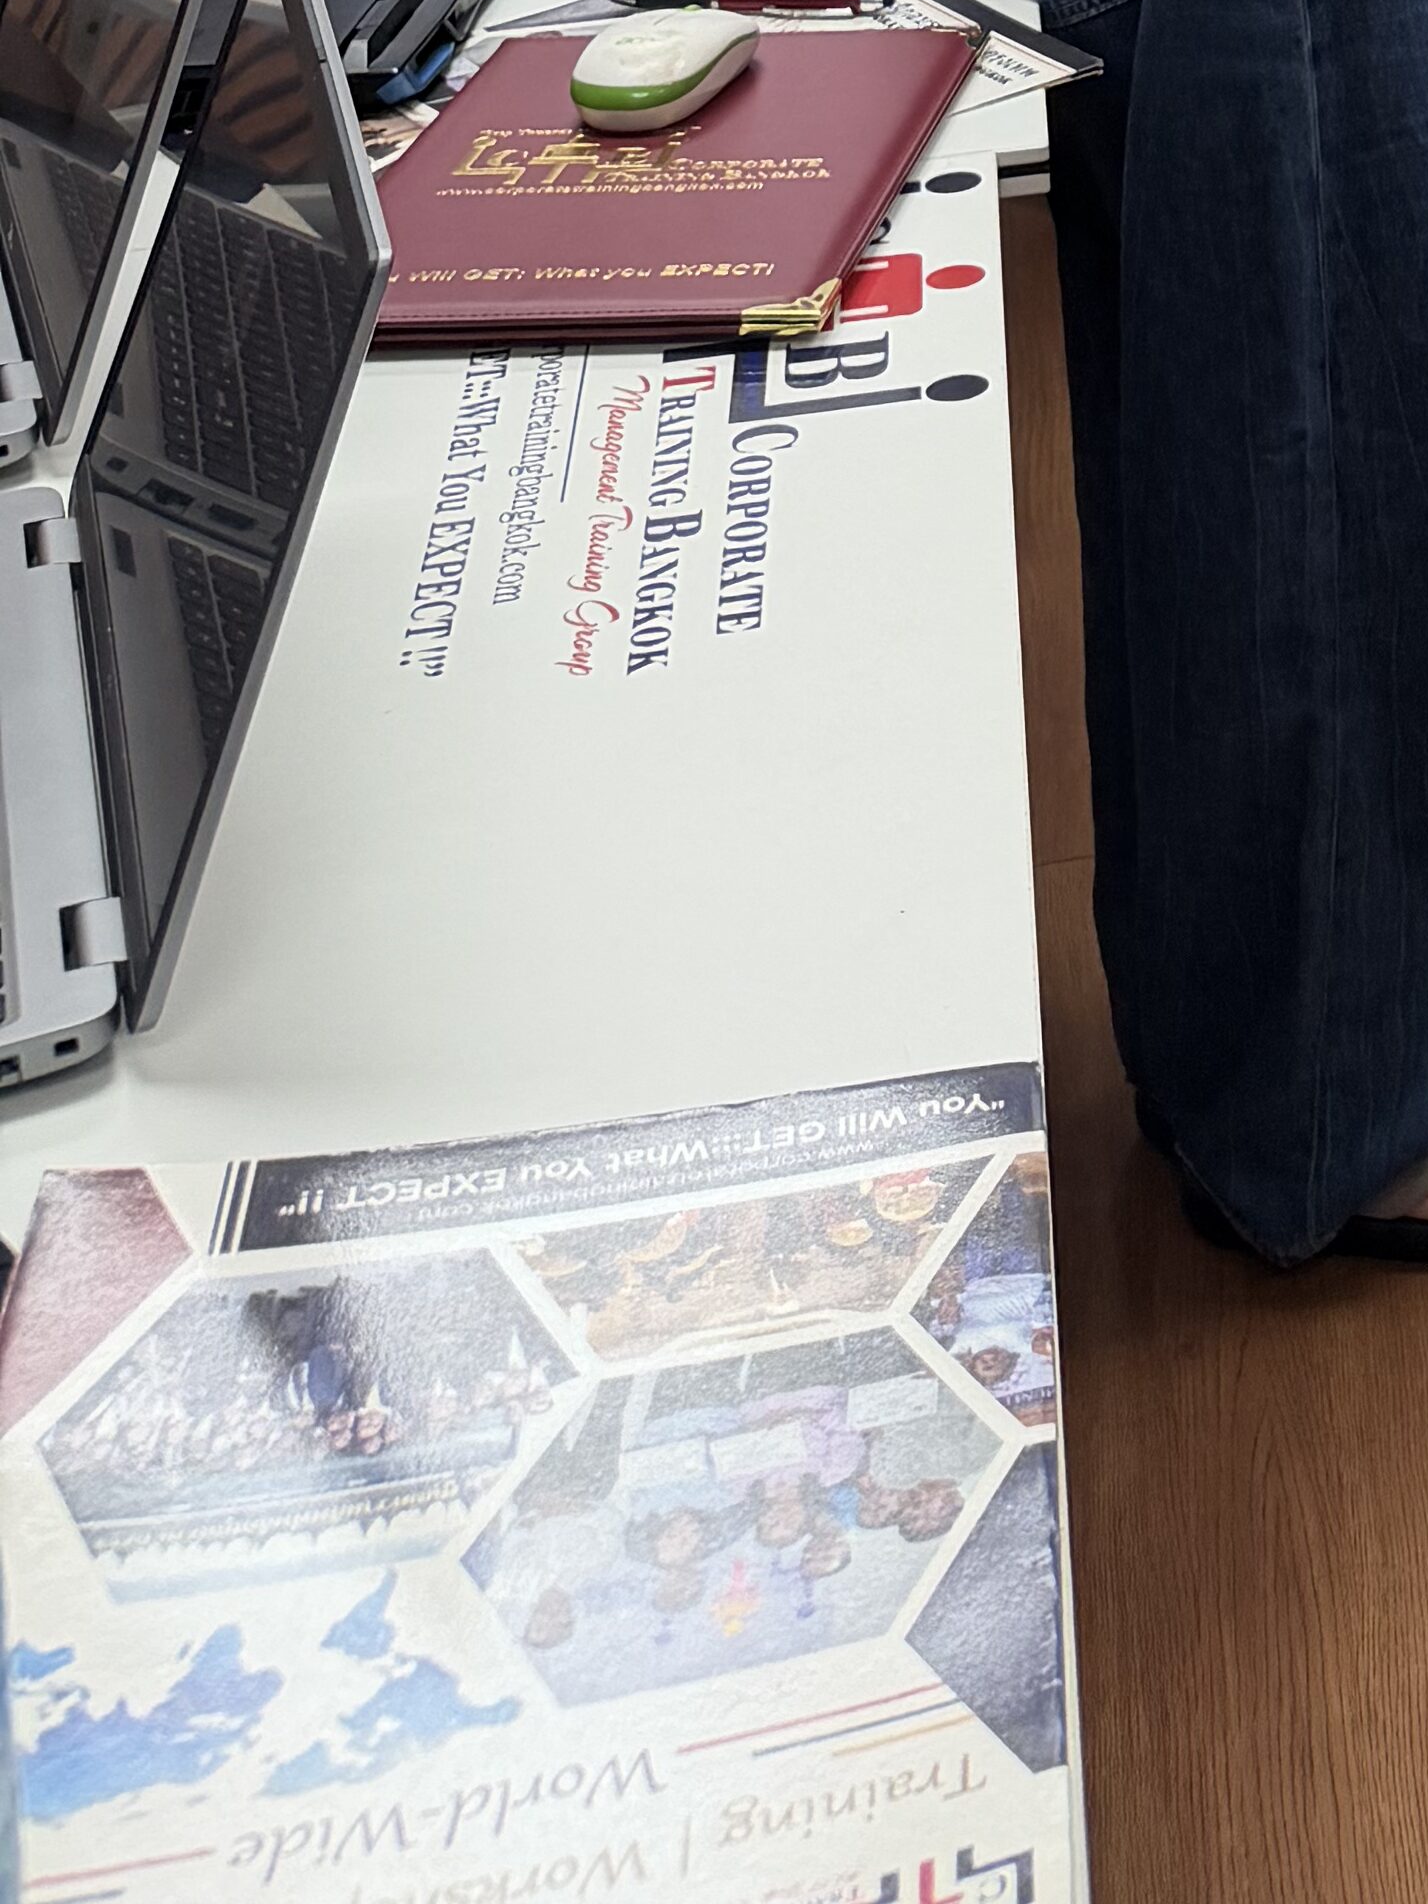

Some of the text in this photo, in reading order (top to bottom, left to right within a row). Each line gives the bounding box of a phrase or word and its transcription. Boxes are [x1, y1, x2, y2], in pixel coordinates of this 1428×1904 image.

[446, 348, 512, 462] ET:::What
[432, 464, 487, 514] You
[492, 346, 568, 606] rporatetrainingbangkok.com
[554, 375, 652, 678] Management Training Group
[626, 365, 717, 677] TRAINING BANGKOK
[715, 422, 801, 636] CORPORATE
[403, 517, 476, 640] EXPECT
[519, 1156, 594, 1184] You
[838, 1104, 908, 1133] Will
[341, 1166, 507, 1206] EXPECT
[228, 1746, 665, 1885] World-Wide
[716, 1752, 988, 1850] Training
